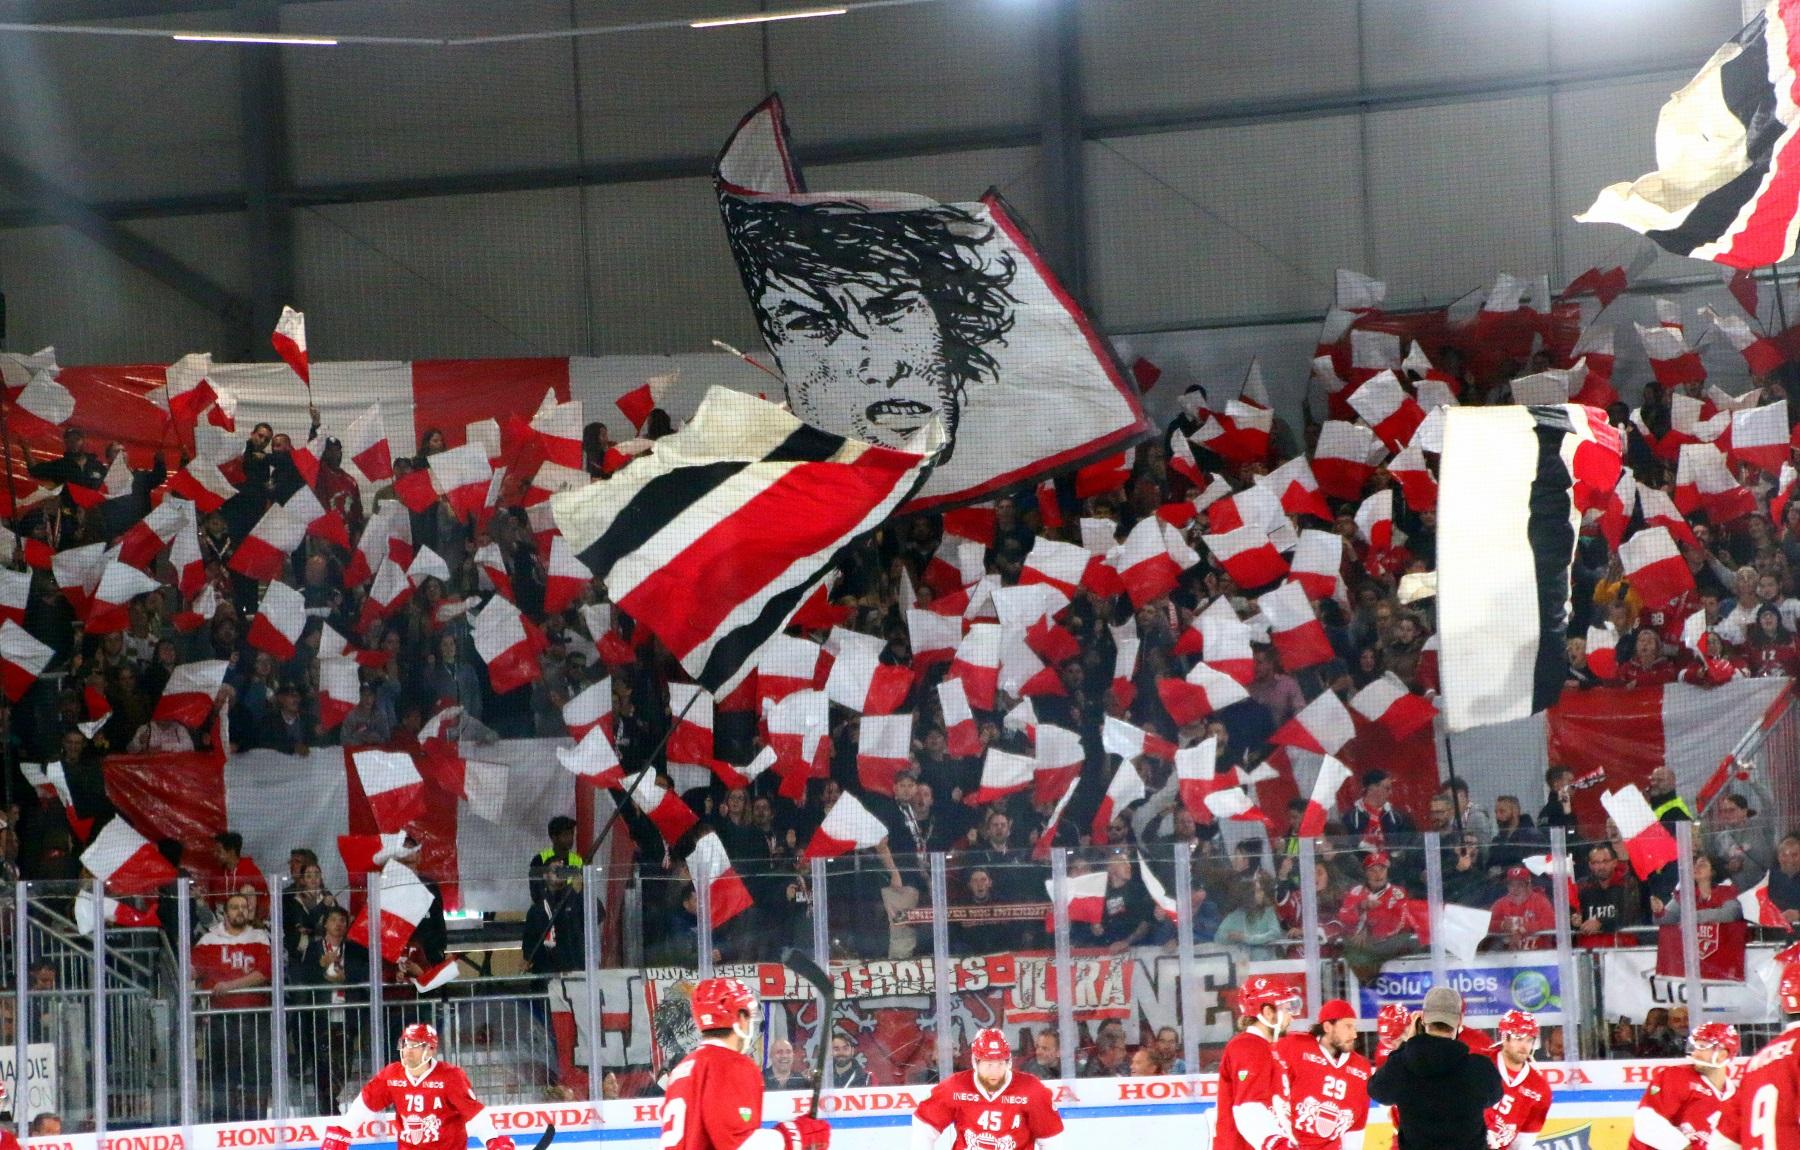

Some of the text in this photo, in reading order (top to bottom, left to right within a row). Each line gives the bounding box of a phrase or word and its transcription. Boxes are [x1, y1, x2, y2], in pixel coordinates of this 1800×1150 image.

[1588, 903, 1616, 919] LHC
[1011, 955, 1130, 1009] ULRA
[1375, 973, 1499, 997] Solu ubes
[953, 1092, 1028, 1105] INEOS INEOS
[1118, 1081, 1219, 1100] HOND
[1322, 1075, 1347, 1101] 29
[405, 1094, 443, 1112] 79 A
[791, 1091, 919, 1114] HONDA
[489, 1107, 606, 1130] HONDA
[976, 1110, 1022, 1132] 45 A
[96, 1133, 187, 1150] HONDA
[217, 1125, 320, 1148] HONDA
